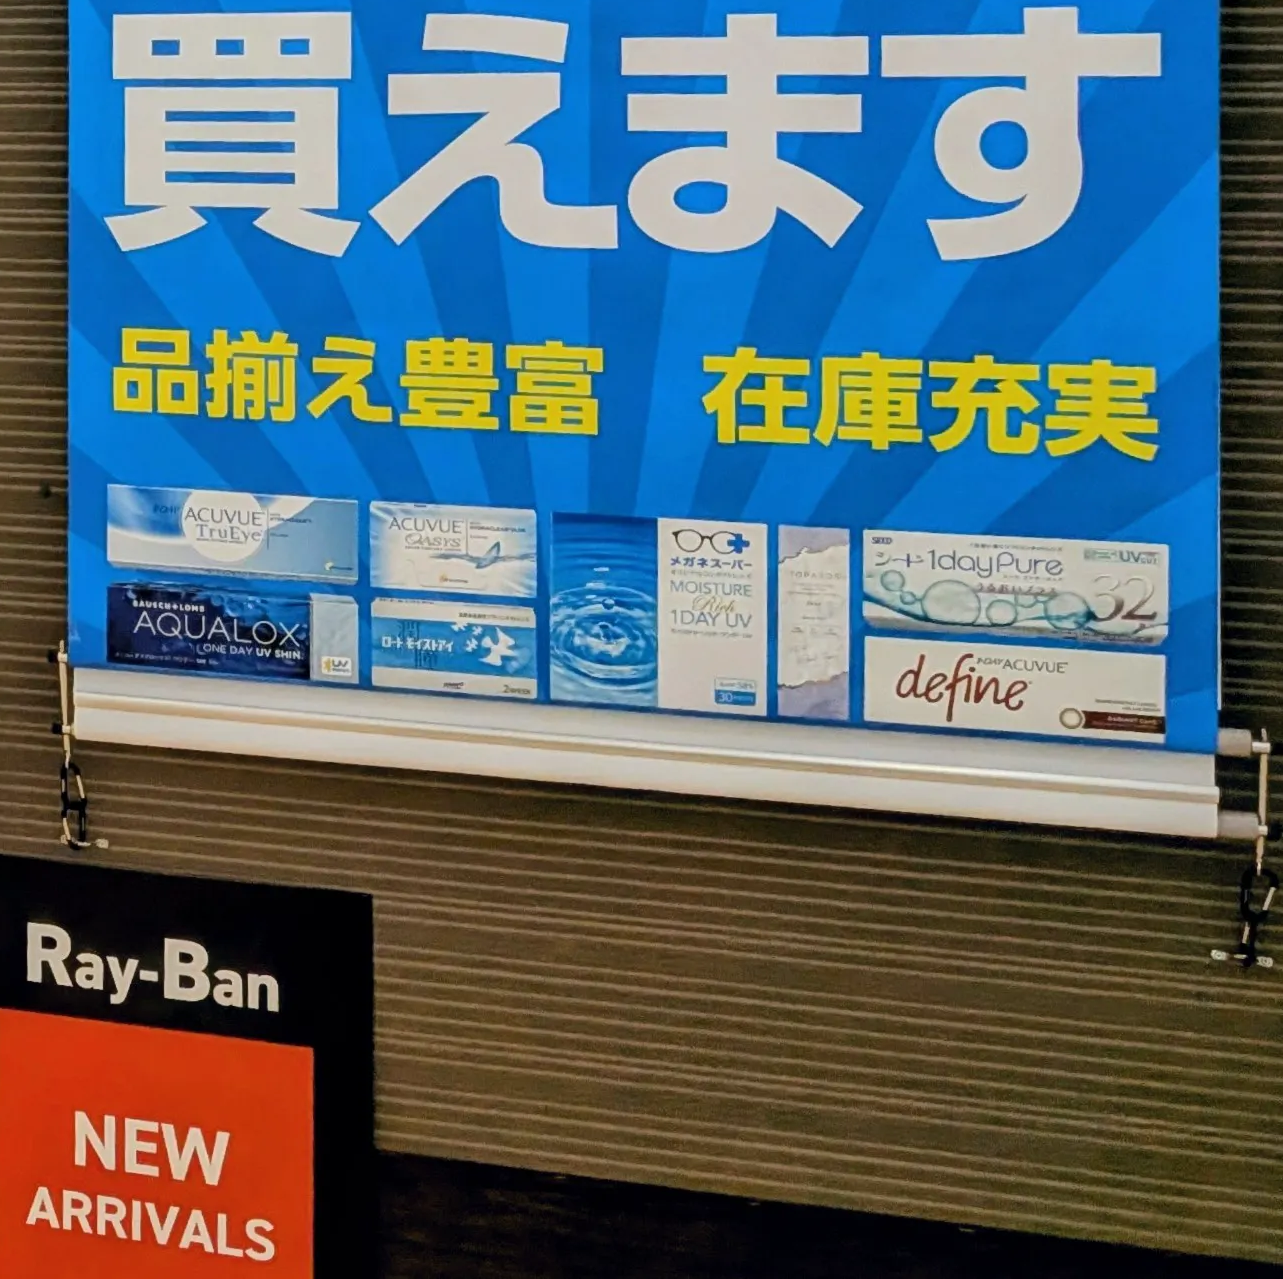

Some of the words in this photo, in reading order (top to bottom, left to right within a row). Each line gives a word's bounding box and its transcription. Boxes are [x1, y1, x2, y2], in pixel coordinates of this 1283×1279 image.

[102, 6, 1163, 261] 買えます
[110, 326, 605, 436] 品揃え豊富
[701, 346, 1161, 462] 在庫充実
[185, 507, 264, 527] ACUVUE
[388, 516, 463, 534] ACUVUE
[196, 524, 263, 542] TruEye
[670, 580, 753, 597] MOISTURE
[1092, 574, 1158, 622] 32
[133, 610, 301, 648] AQUALOX
[671, 609, 721, 627] 1DAY
[726, 614, 752, 628] UV
[229, 645, 253, 656] DAY
[255, 647, 271, 658] UV
[381, 636, 404, 650] ロート
[1002, 659, 1066, 673] ACUVUE
[896, 653, 1028, 722] define
[26, 921, 280, 1013] Ray-Ban
[73, 1109, 230, 1186] NEW
[25, 1186, 276, 1262] ARRIVALS
